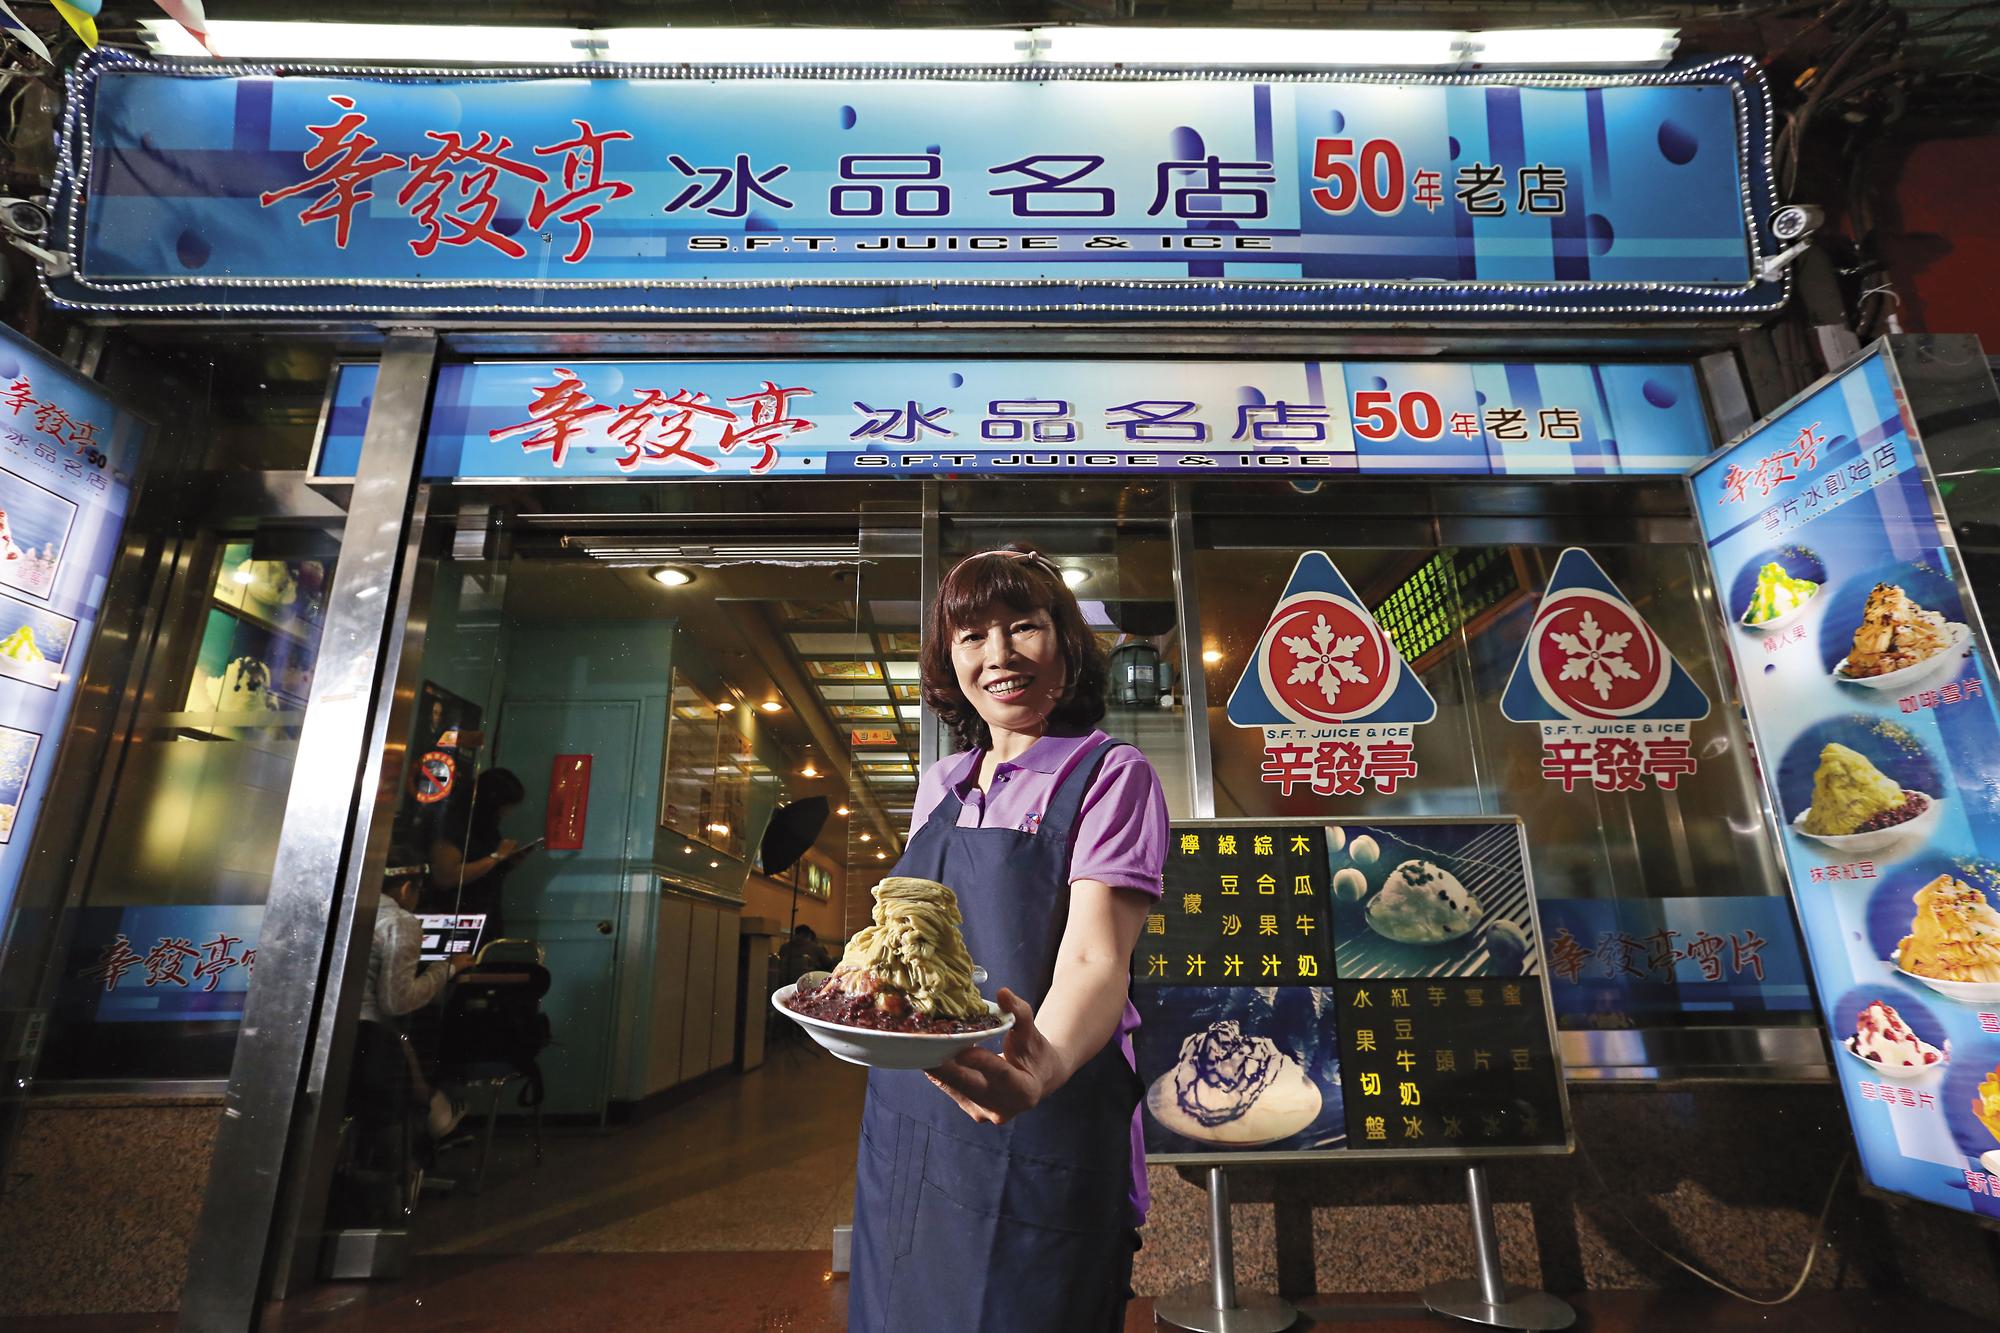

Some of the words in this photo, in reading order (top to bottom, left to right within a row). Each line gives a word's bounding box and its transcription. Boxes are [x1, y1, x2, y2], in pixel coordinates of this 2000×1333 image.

[260, 95, 636, 265] 辛發亭
[664, 153, 1277, 221] 冰品名店
[1310, 137, 1568, 217] 50年老店
[687, 235, 839, 252] S.F.T.
[856, 235, 1060, 252] JUICE
[1083, 235, 1131, 251] &
[1159, 234, 1274, 251] ICE
[4, 427, 108, 491] 冰品名店
[489, 367, 818, 476] 辛發亭
[848, 400, 1332, 444] 冰品名店
[1354, 390, 1582, 442] 50年老店
[853, 453, 979, 468] S.F.T.
[991, 454, 1160, 468] JUICE
[1177, 455, 1218, 467] &
[1239, 454, 1333, 467] ICE
[1719, 421, 1826, 506] 辛發亭
[1760, 441, 1898, 532] 雪片冰創始店
[1261, 740, 1417, 796] 辛發亭
[1266, 729, 1307, 739] S.F.T.
[1311, 728, 1361, 738] JUICE
[1366, 728, 1377, 737] &
[1382, 727, 1410, 737] ICE
[1541, 736, 1697, 792] 辛發亭
[1544, 726, 1583, 735] S.F.T.
[1587, 723, 1637, 735] JUICE
[1642, 724, 1654, 733] &
[1658, 723, 1686, 733] ICE
[1180, 834, 1206, 977] 檸檬汁
[1218, 835, 1244, 977] 綠豆沙汁
[1254, 835, 1281, 977] 綜合果汁
[1290, 835, 1318, 977] 木瓜牛奶
[1549, 928, 1767, 984] 辛發亭雪片
[1353, 988, 1387, 1140] 水果切盤
[1391, 987, 1424, 1139] 紅豆牛奶冰
[1427, 986, 1463, 1137] 芋頭冰
